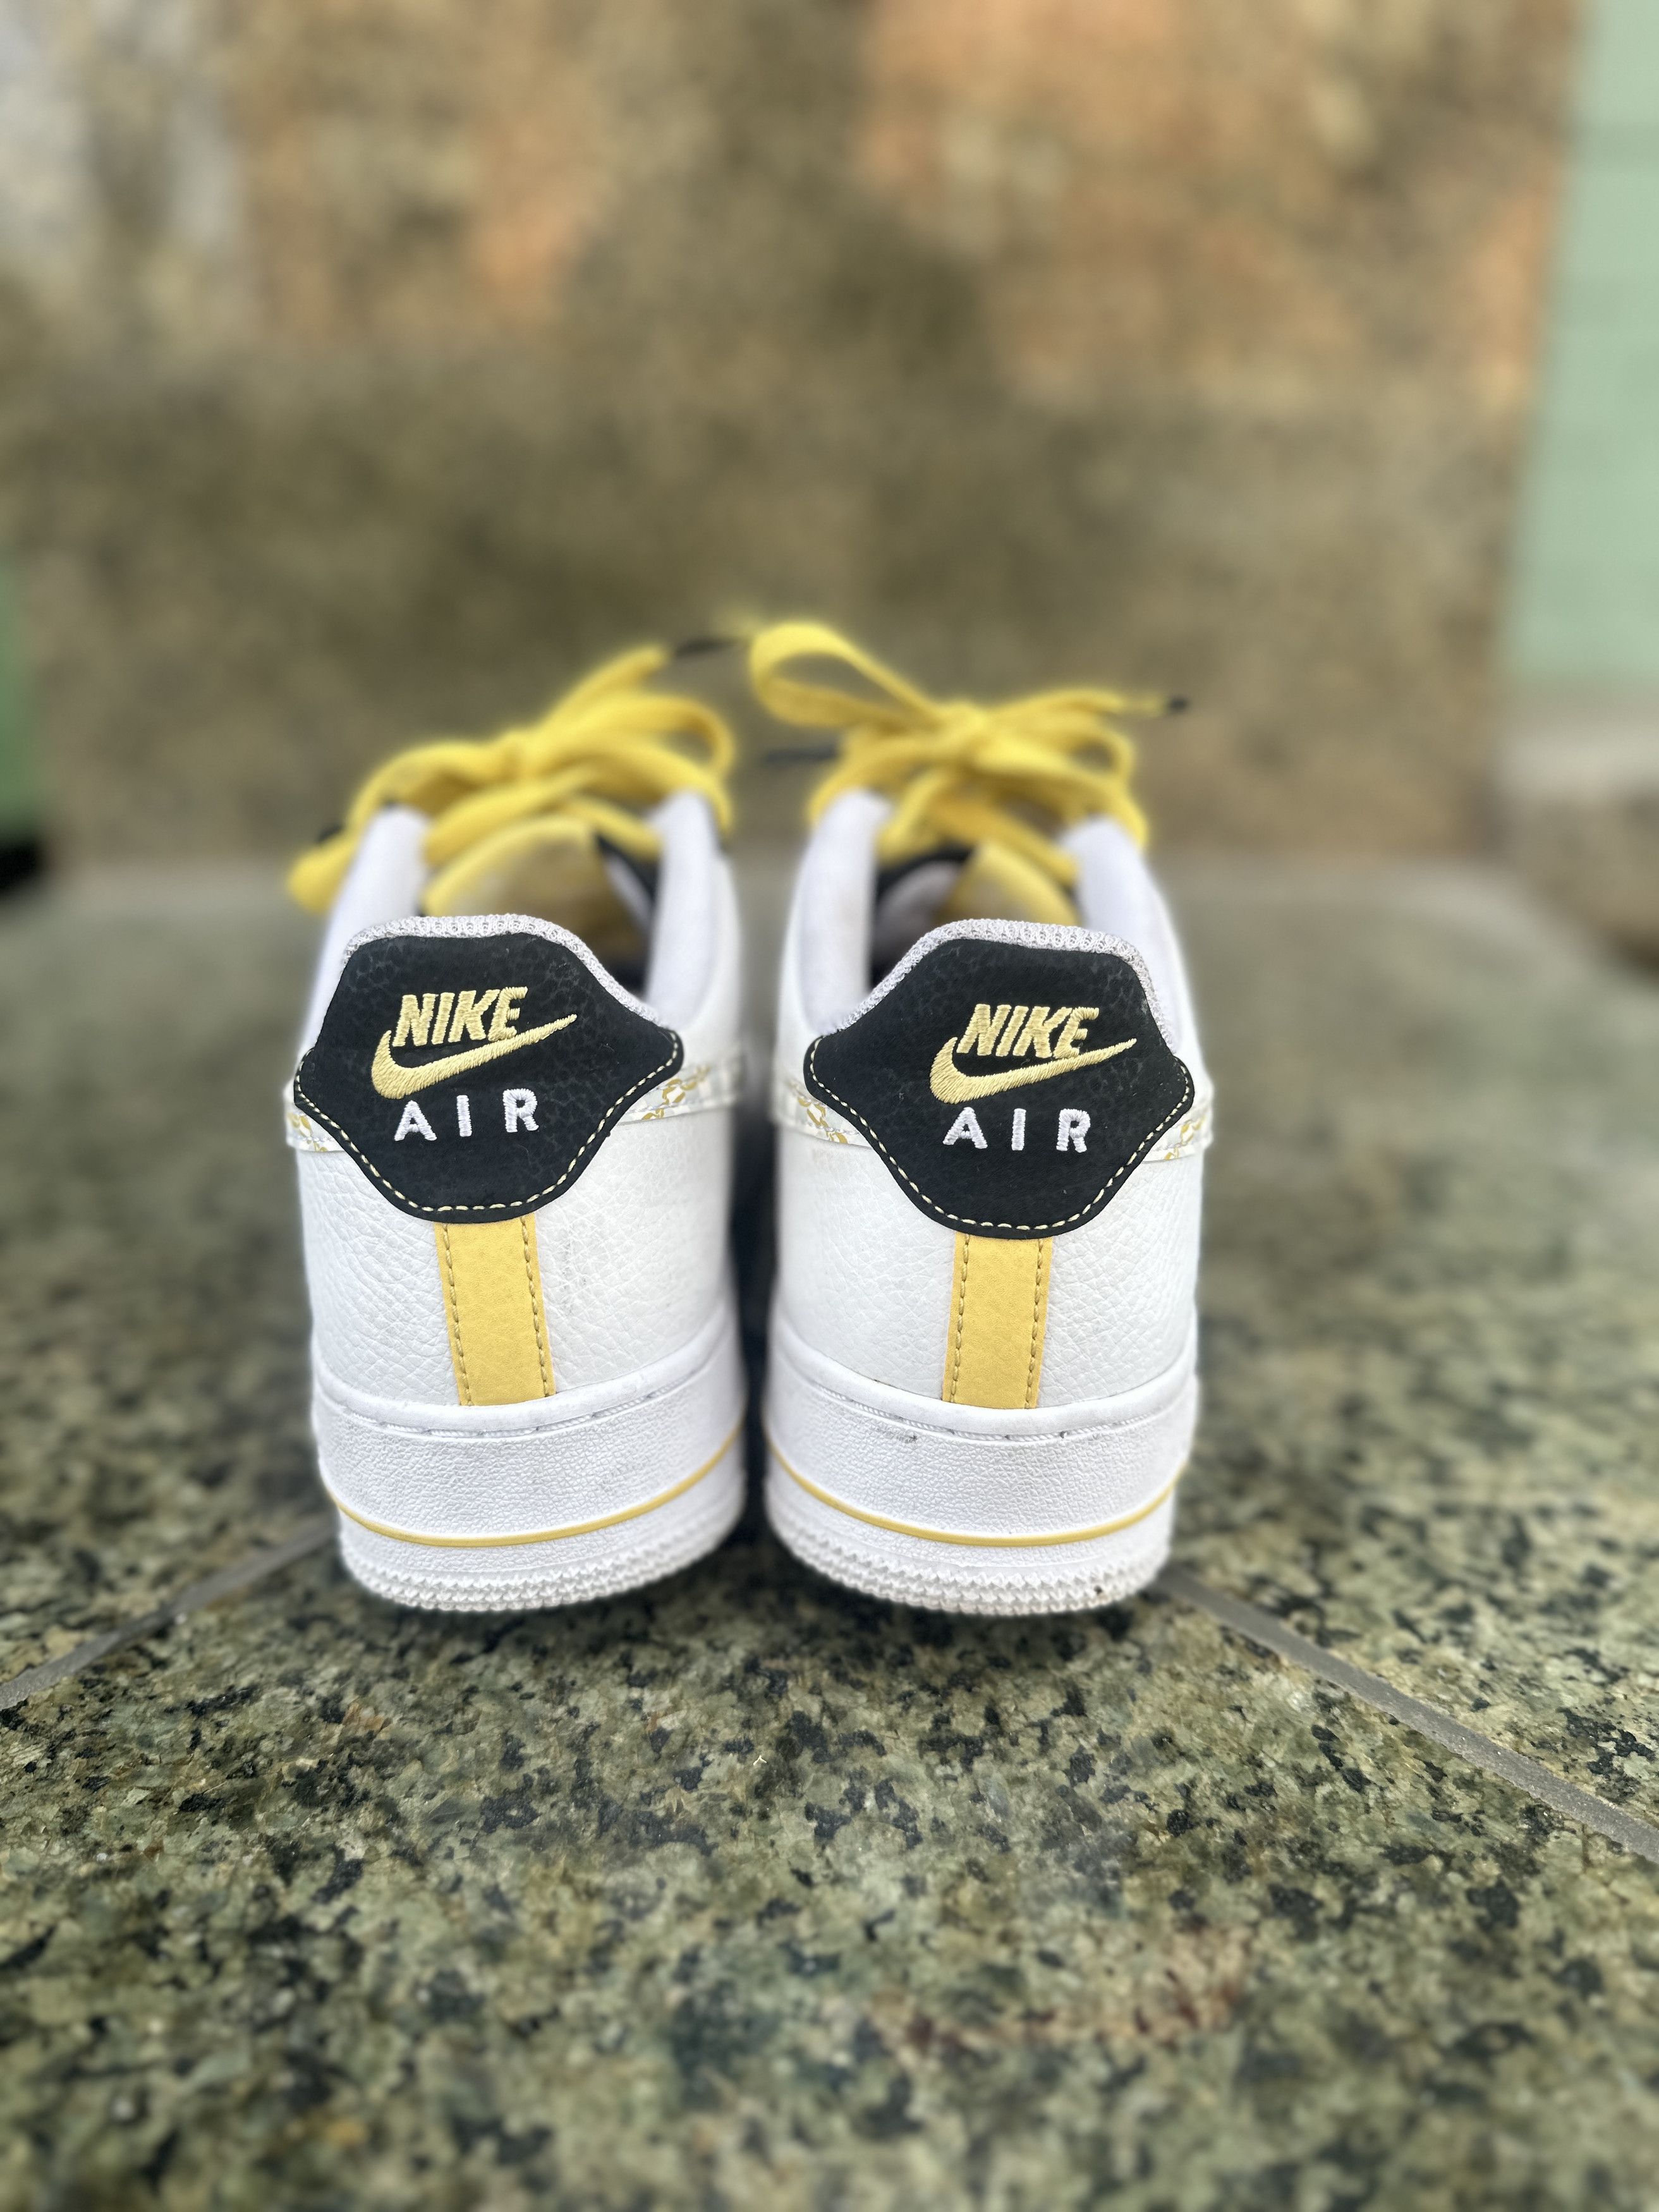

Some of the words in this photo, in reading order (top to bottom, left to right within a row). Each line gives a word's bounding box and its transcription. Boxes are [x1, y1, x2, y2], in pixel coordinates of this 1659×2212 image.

[392, 986, 528, 1047] NIKE
[956, 1004, 1100, 1059] NIKE
[394, 1088, 540, 1141] AIR
[942, 1107, 1091, 1153] AIR
